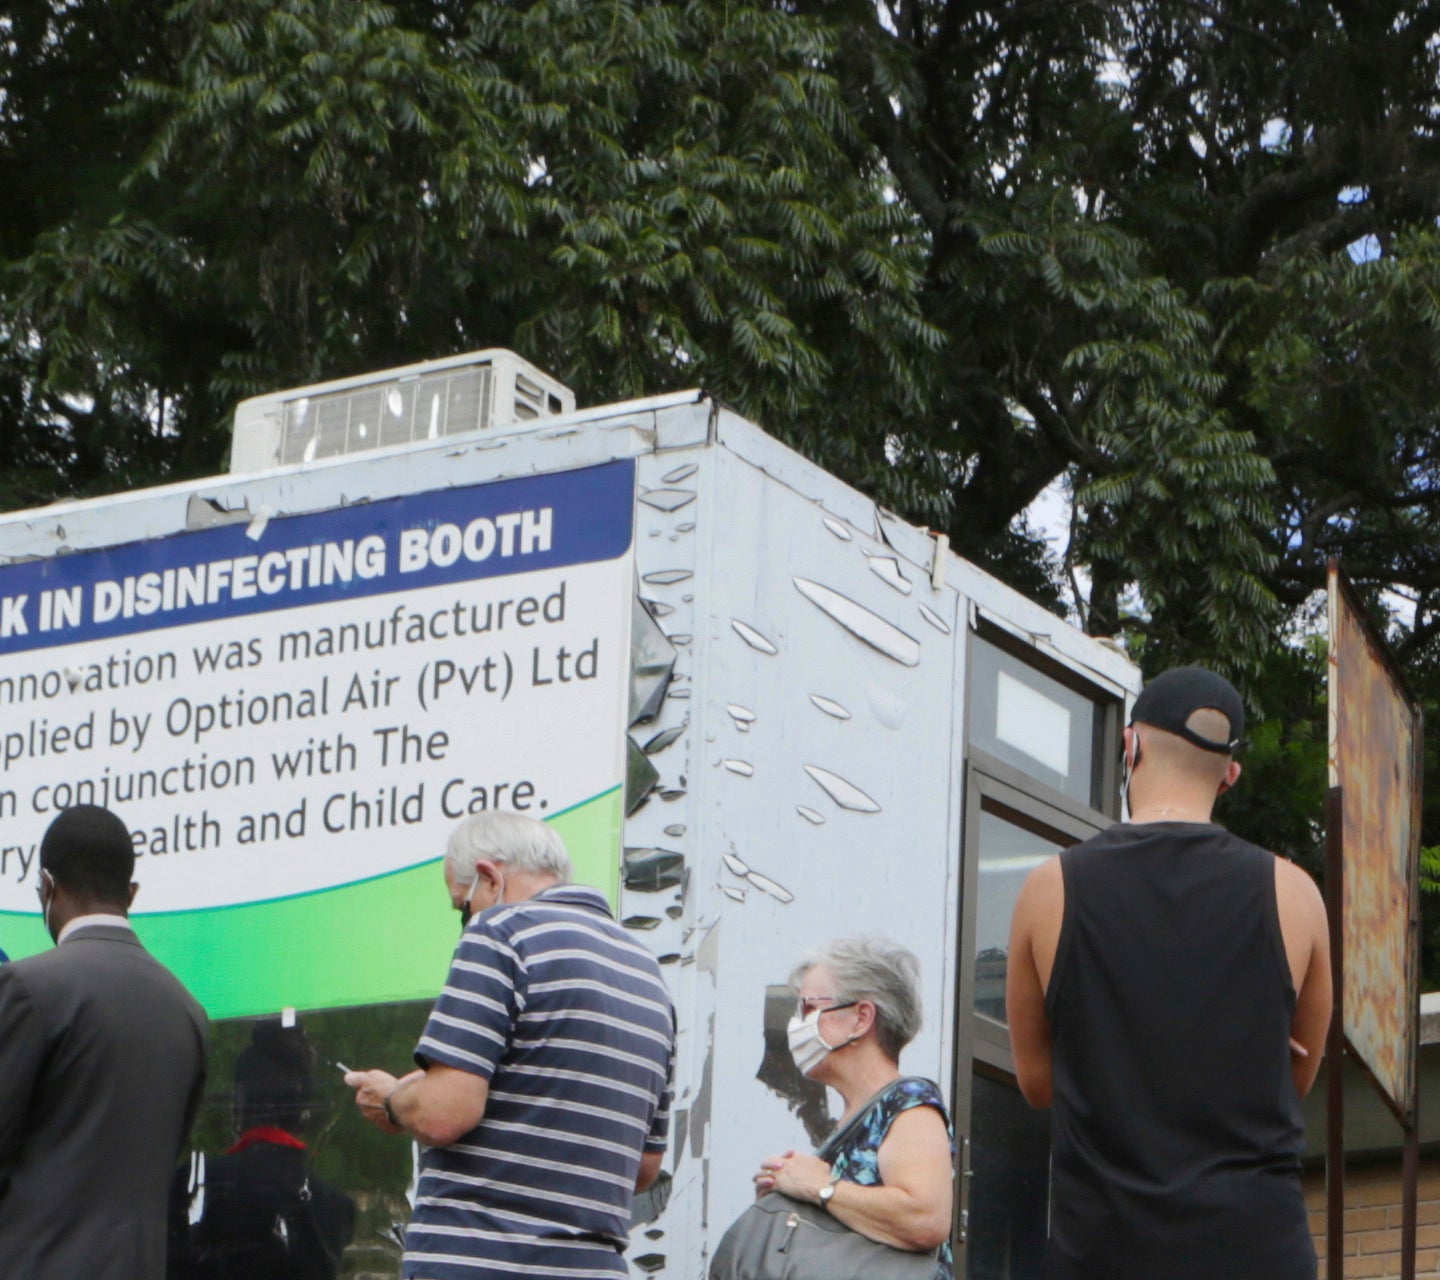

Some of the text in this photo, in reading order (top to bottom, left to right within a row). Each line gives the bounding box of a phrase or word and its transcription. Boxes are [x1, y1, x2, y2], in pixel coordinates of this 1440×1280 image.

[39, 587, 84, 632] IN
[93, 537, 386, 622] DISINFECTING
[399, 508, 553, 572] BOOTH
[193, 638, 263, 673] was
[279, 581, 567, 661] manufactured
[109, 708, 152, 754] by
[165, 676, 329, 744] Optional
[343, 669, 400, 712] Air
[417, 652, 513, 712] (Pvt)
[532, 638, 599, 687] Ltd
[31, 753, 255, 813] conjunction
[272, 734, 357, 779] with
[373, 724, 450, 766] The
[132, 811, 221, 858] ealth
[237, 797, 306, 845] and
[322, 782, 424, 834] Child
[440, 777, 548, 819] Care.
